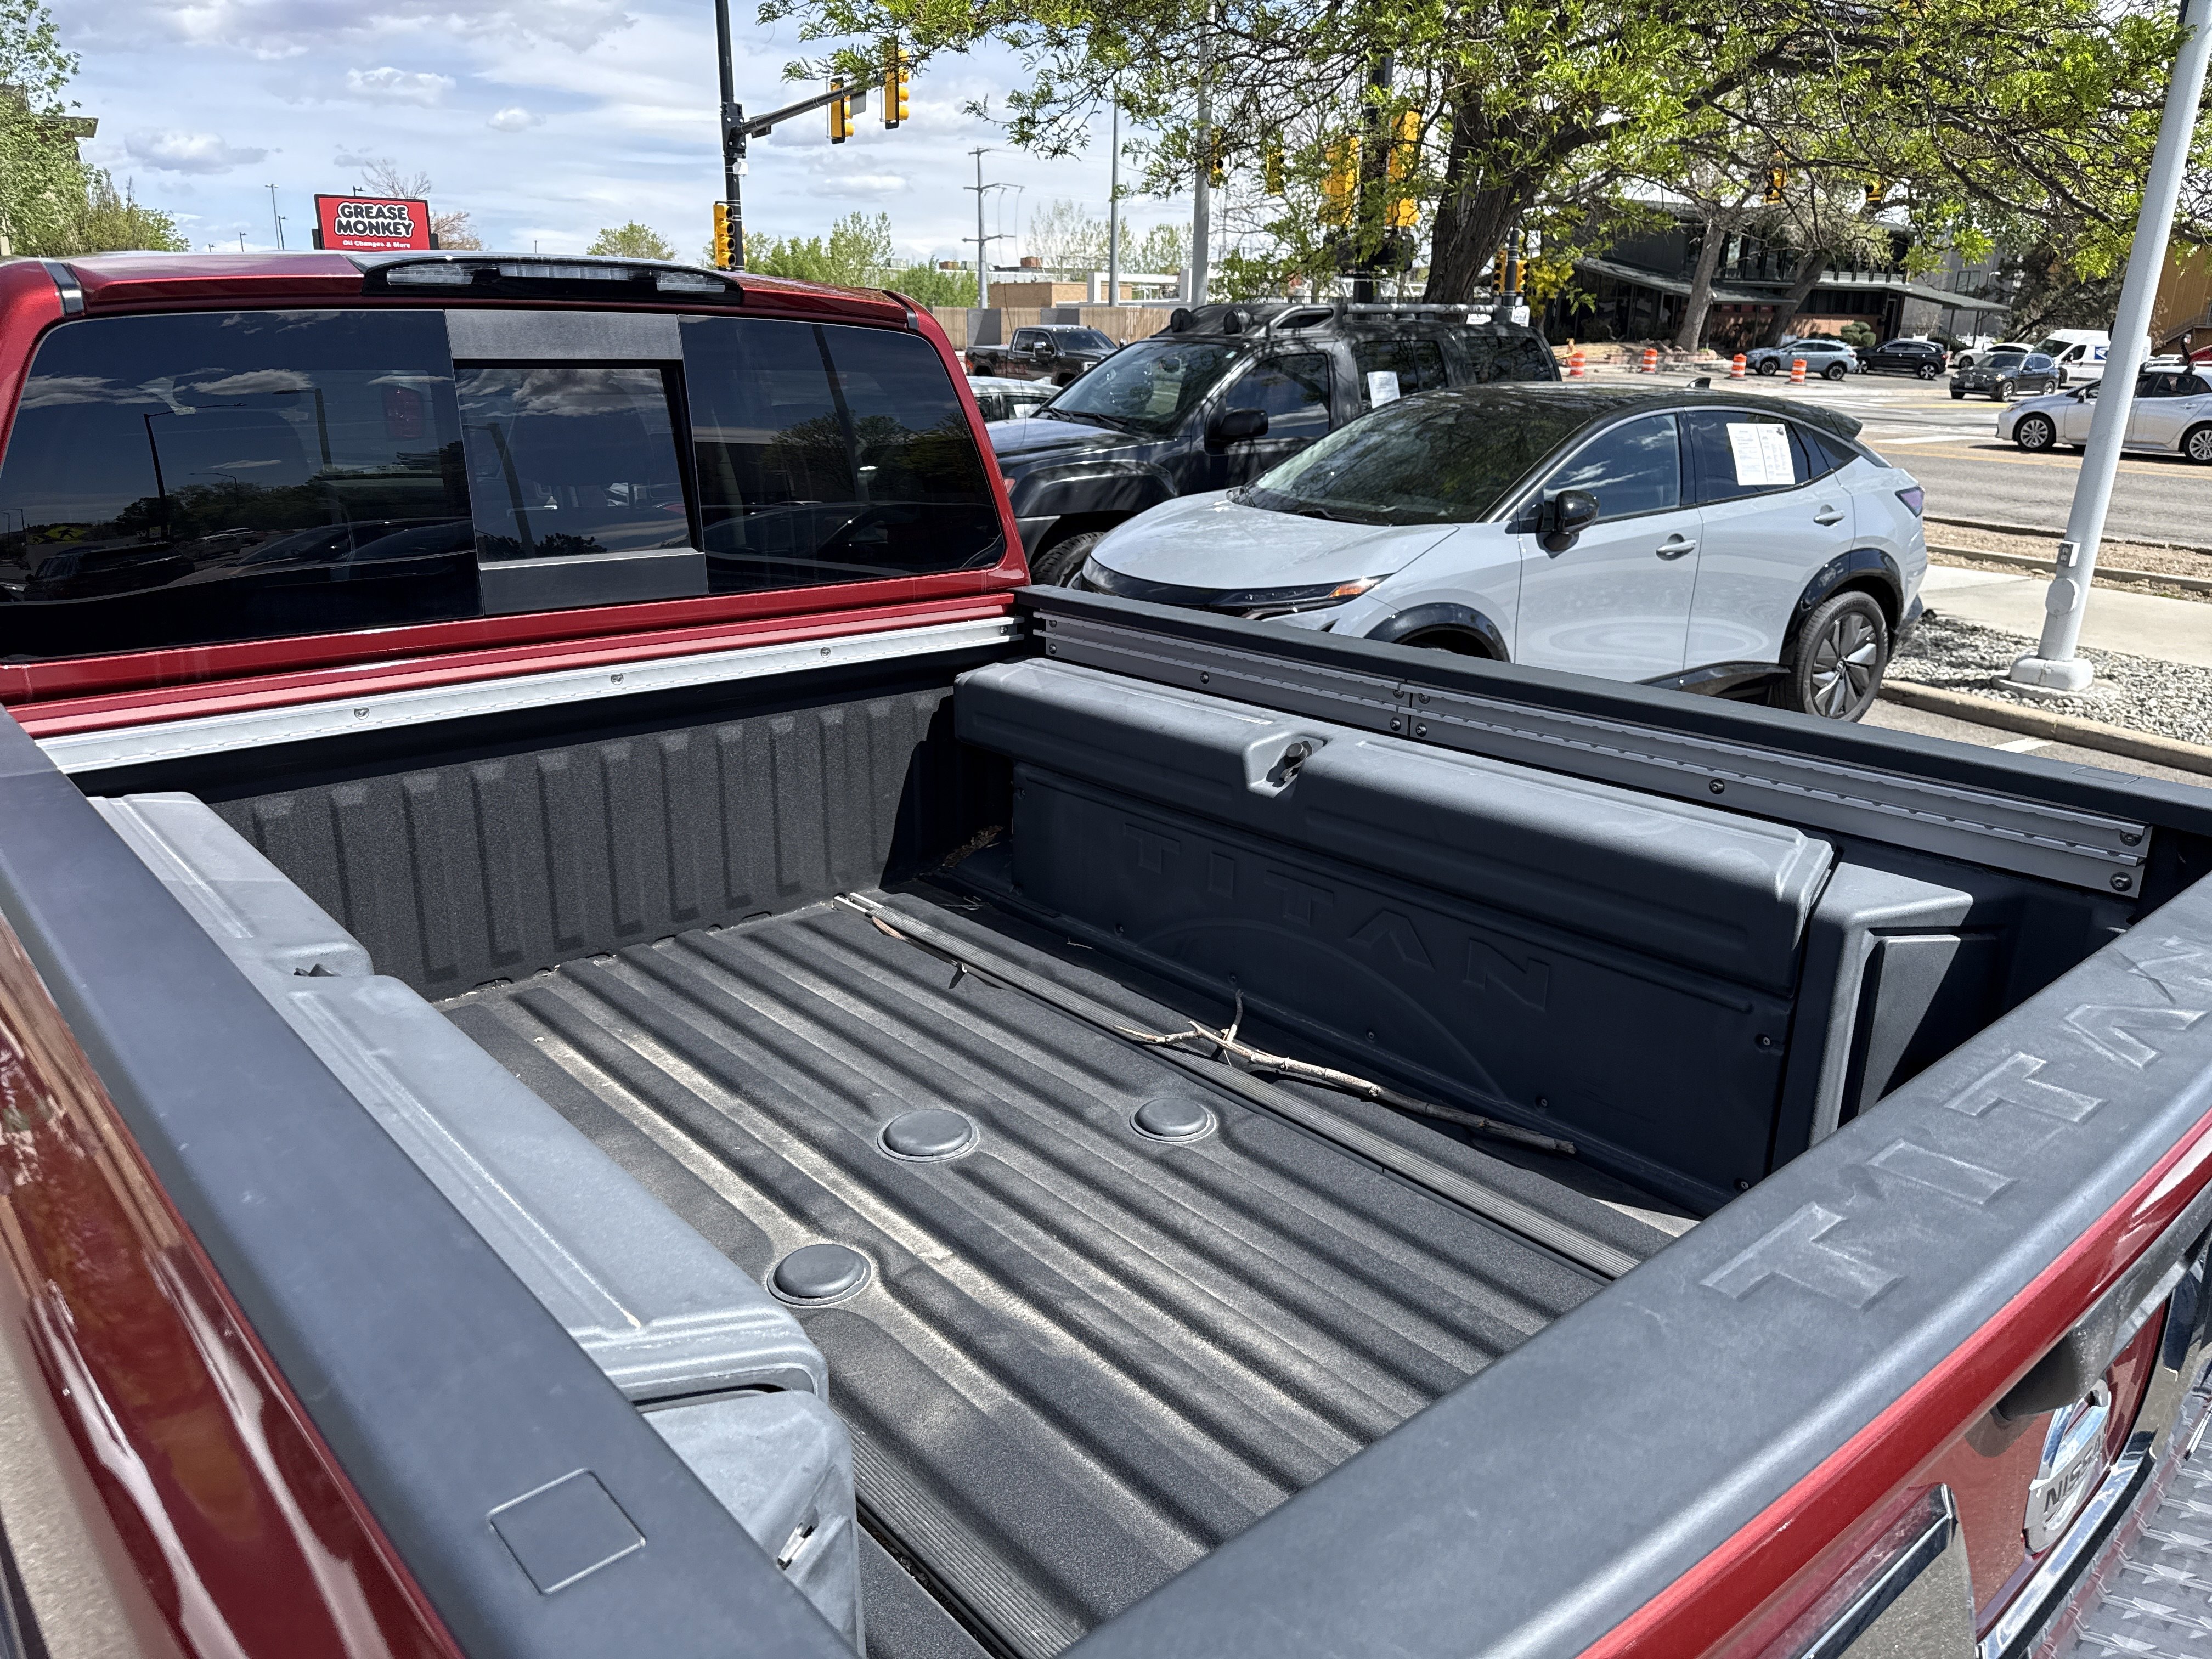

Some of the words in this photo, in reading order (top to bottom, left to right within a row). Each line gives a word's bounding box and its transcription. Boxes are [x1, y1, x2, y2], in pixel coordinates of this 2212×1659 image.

[337, 220, 412, 235] MONKEY
[340, 205, 407, 220] GREASE
[1124, 823, 1551, 1011] TITAN
[2044, 1432, 2102, 1514] NISSA
